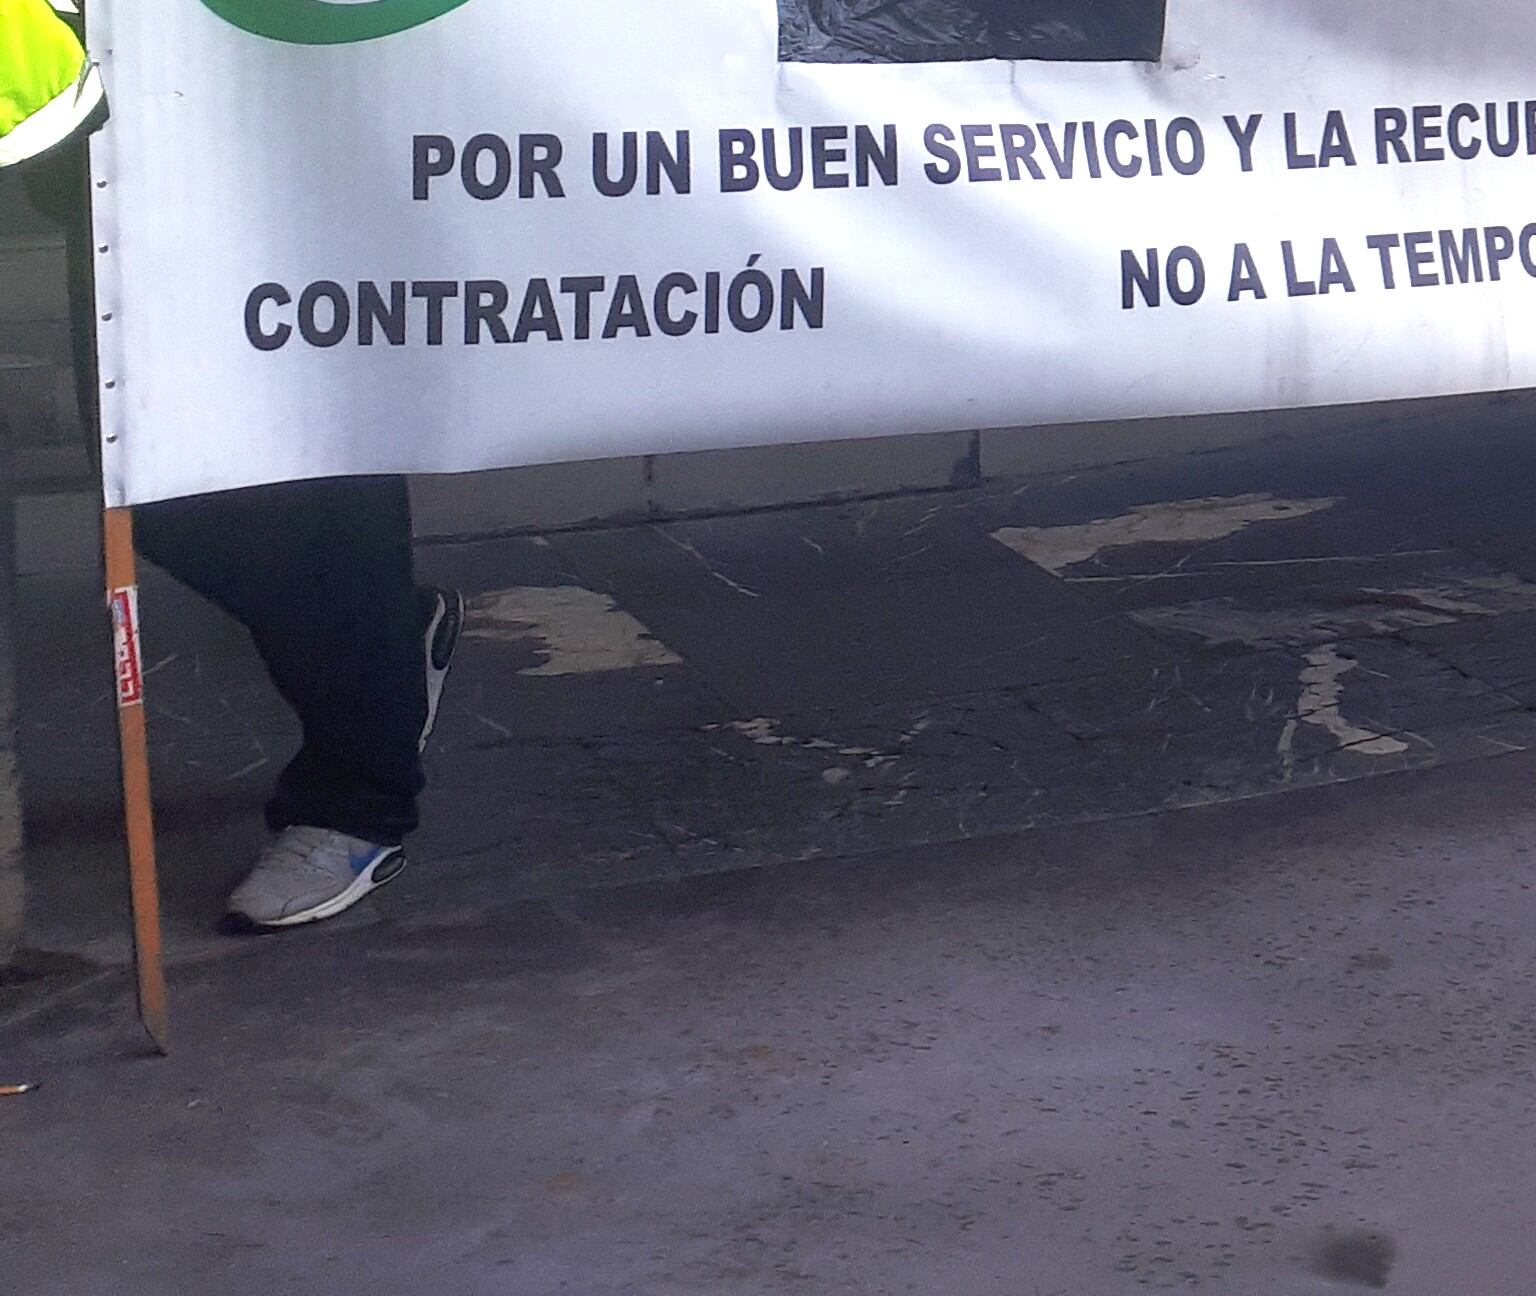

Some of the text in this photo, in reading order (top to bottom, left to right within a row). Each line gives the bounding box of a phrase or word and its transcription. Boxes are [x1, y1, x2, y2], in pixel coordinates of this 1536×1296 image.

[411, 132, 566, 201] POR
[591, 129, 692, 197] UN
[718, 123, 900, 194] BUEN
[922, 116, 1206, 186] SERVICIO
[1223, 114, 1263, 172] Y
[1284, 110, 1356, 171] LA
[243, 253, 826, 352] CONTRATACIÓN
[1119, 245, 1206, 310] NO
[1227, 242, 1267, 303] A
[1281, 237, 1356, 298] LA
